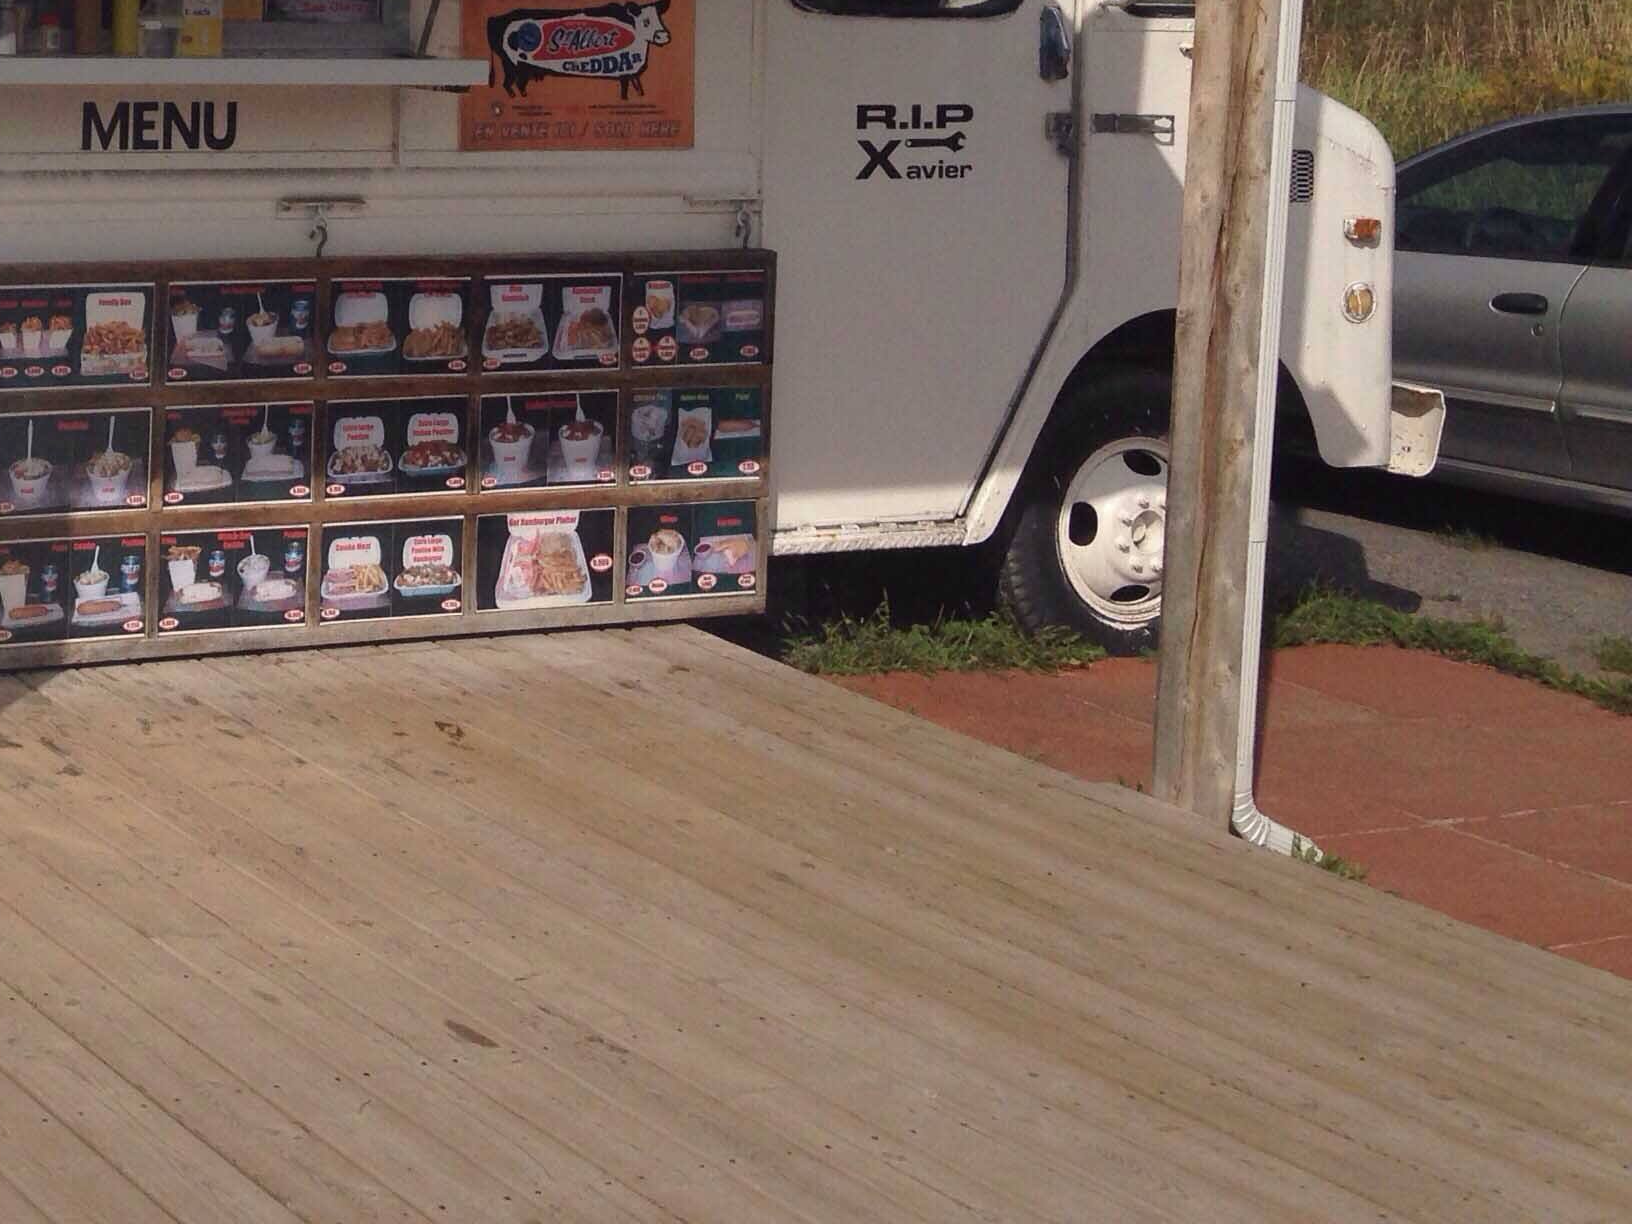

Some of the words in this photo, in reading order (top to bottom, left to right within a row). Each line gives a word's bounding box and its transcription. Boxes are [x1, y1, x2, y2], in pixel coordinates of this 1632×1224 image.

[80, 101, 238, 151] MENU
[855, 104, 974, 129] R.I.P
[855, 140, 973, 180] Xavier
